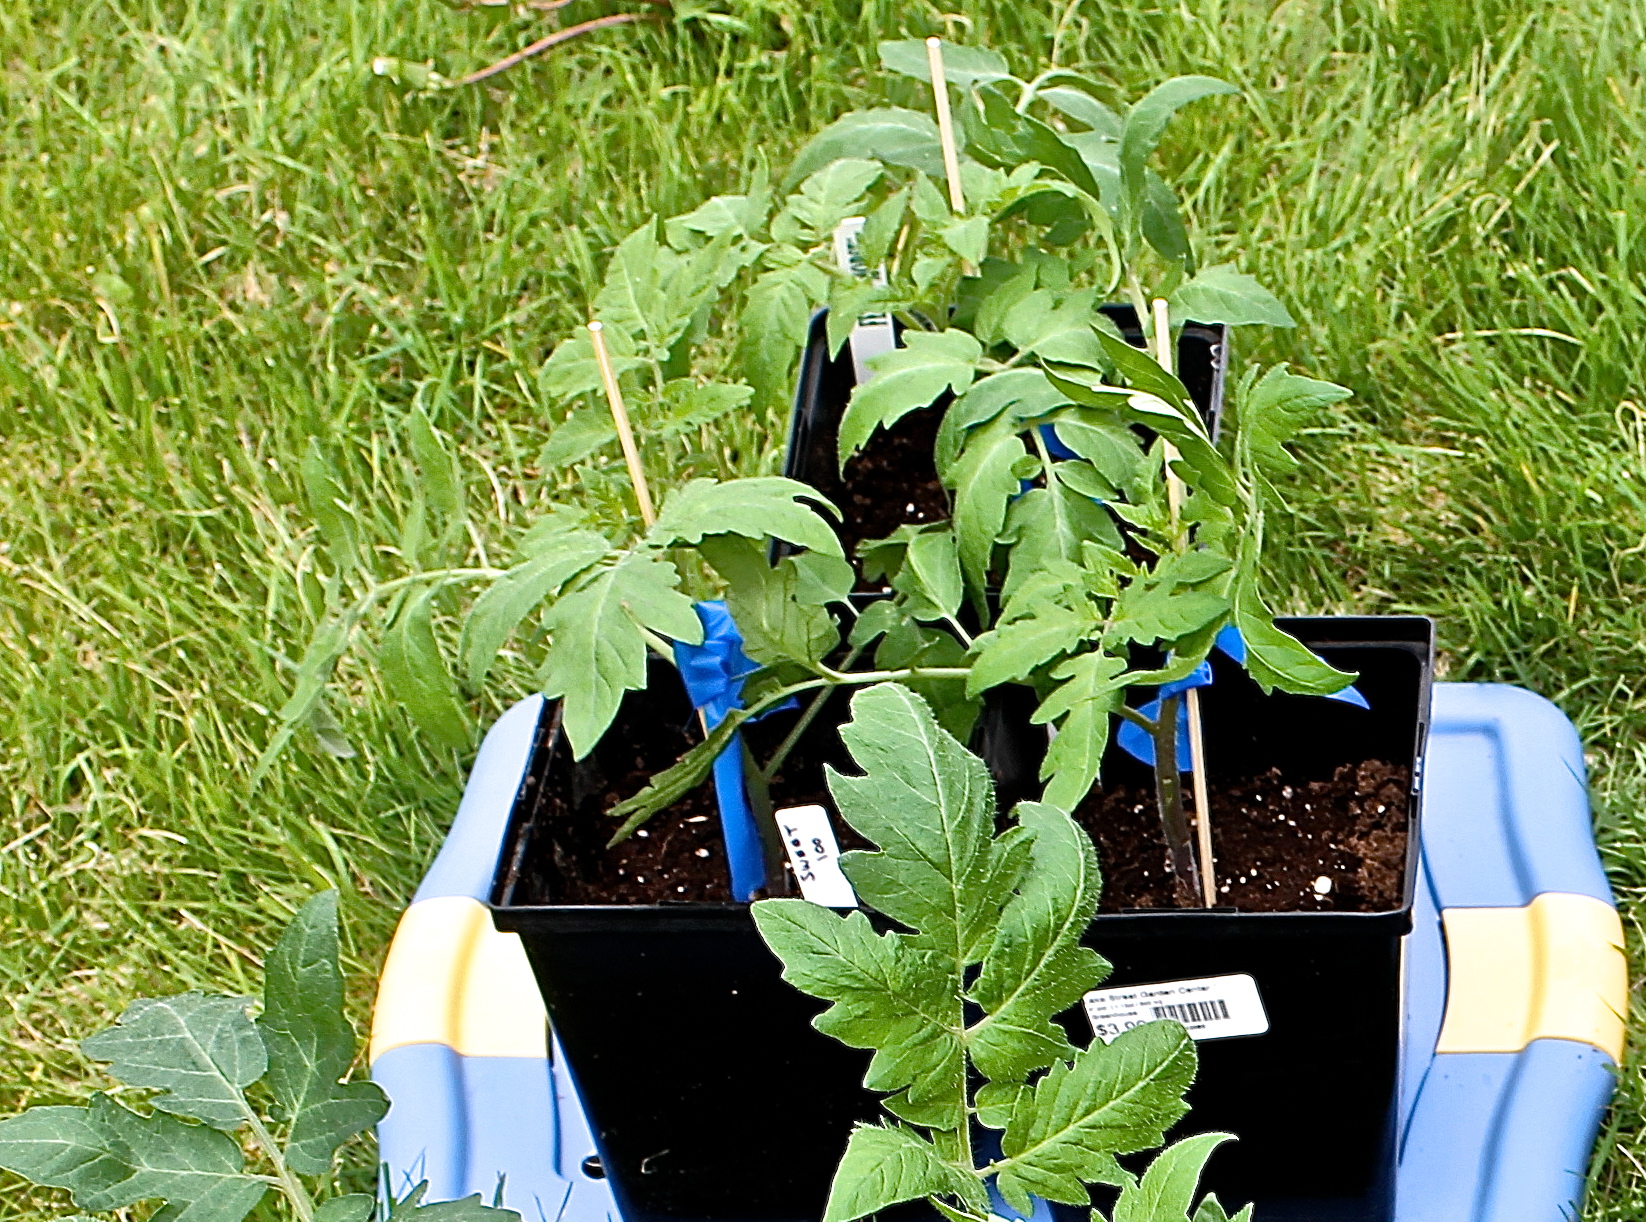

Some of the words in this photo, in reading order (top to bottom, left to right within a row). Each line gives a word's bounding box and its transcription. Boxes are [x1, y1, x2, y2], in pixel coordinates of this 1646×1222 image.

[783, 825, 816, 881] SWEET
[811, 837, 828, 861] 100
[1109, 992, 1138, 1000] Street
[1140, 989, 1176, 997] Garden
[1178, 986, 1210, 994] Center
[1091, 1011, 1138, 1019] Greenhouse
